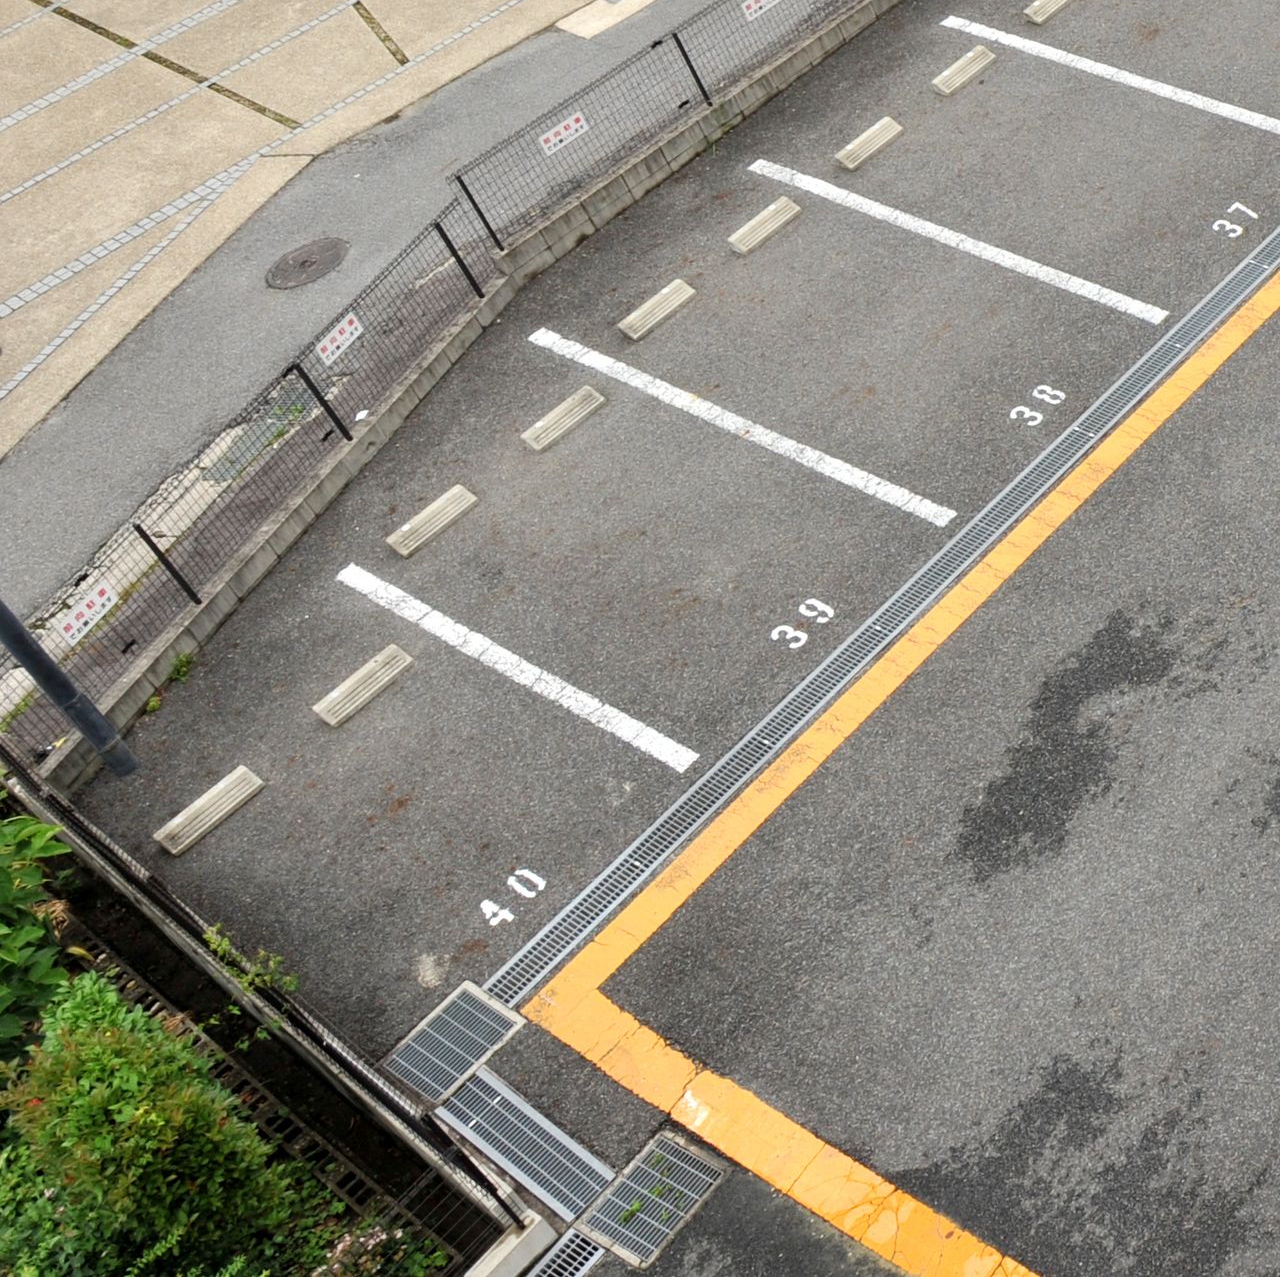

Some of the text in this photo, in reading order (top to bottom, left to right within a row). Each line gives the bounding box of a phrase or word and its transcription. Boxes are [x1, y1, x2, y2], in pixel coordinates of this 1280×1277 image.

[1212, 200, 1259, 238] 37
[1009, 383, 1066, 427] 38
[770, 597, 835, 649] 39
[479, 868, 548, 927] 40
